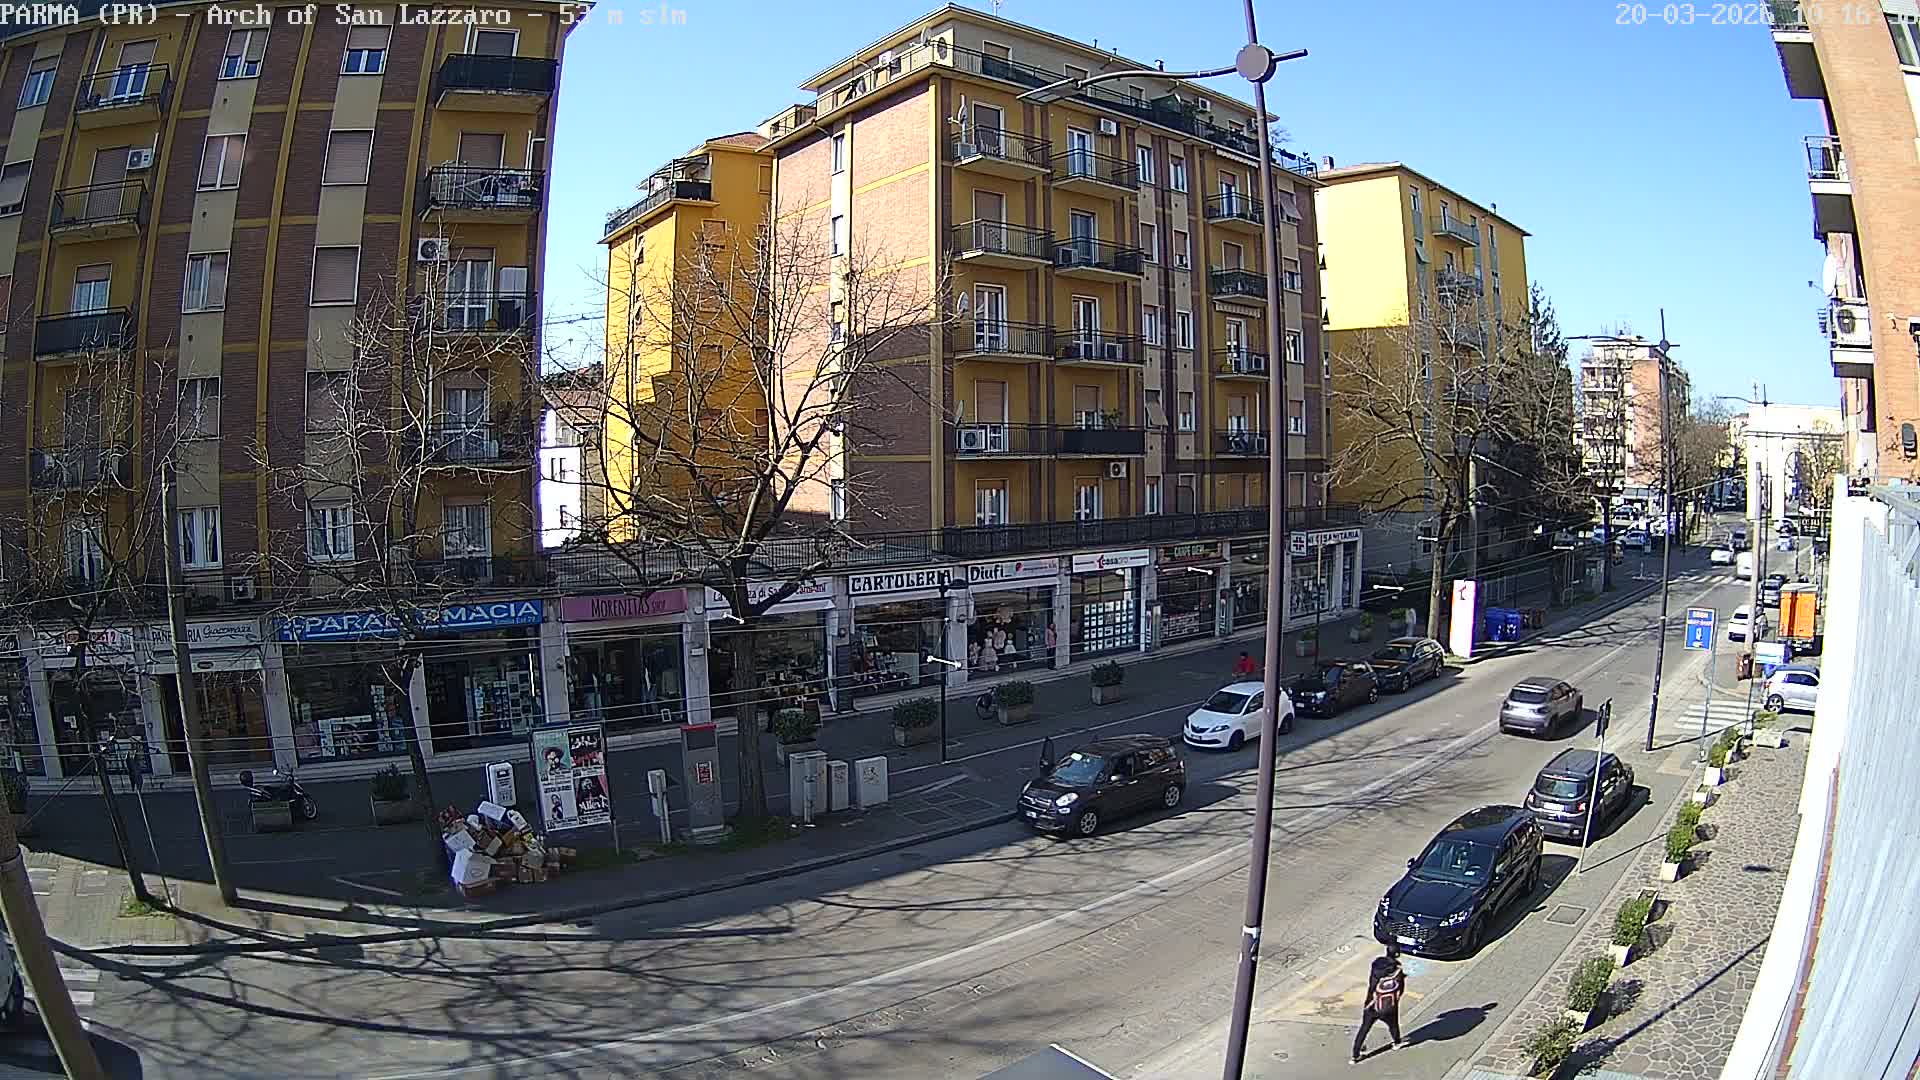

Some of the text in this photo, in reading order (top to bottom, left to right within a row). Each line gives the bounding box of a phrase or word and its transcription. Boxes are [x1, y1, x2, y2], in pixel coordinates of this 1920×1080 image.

[851, 570, 950, 592] CARTOLERIA
[306, 602, 538, 632] PARAMACIA
[152, 629, 202, 644] PANERIA
